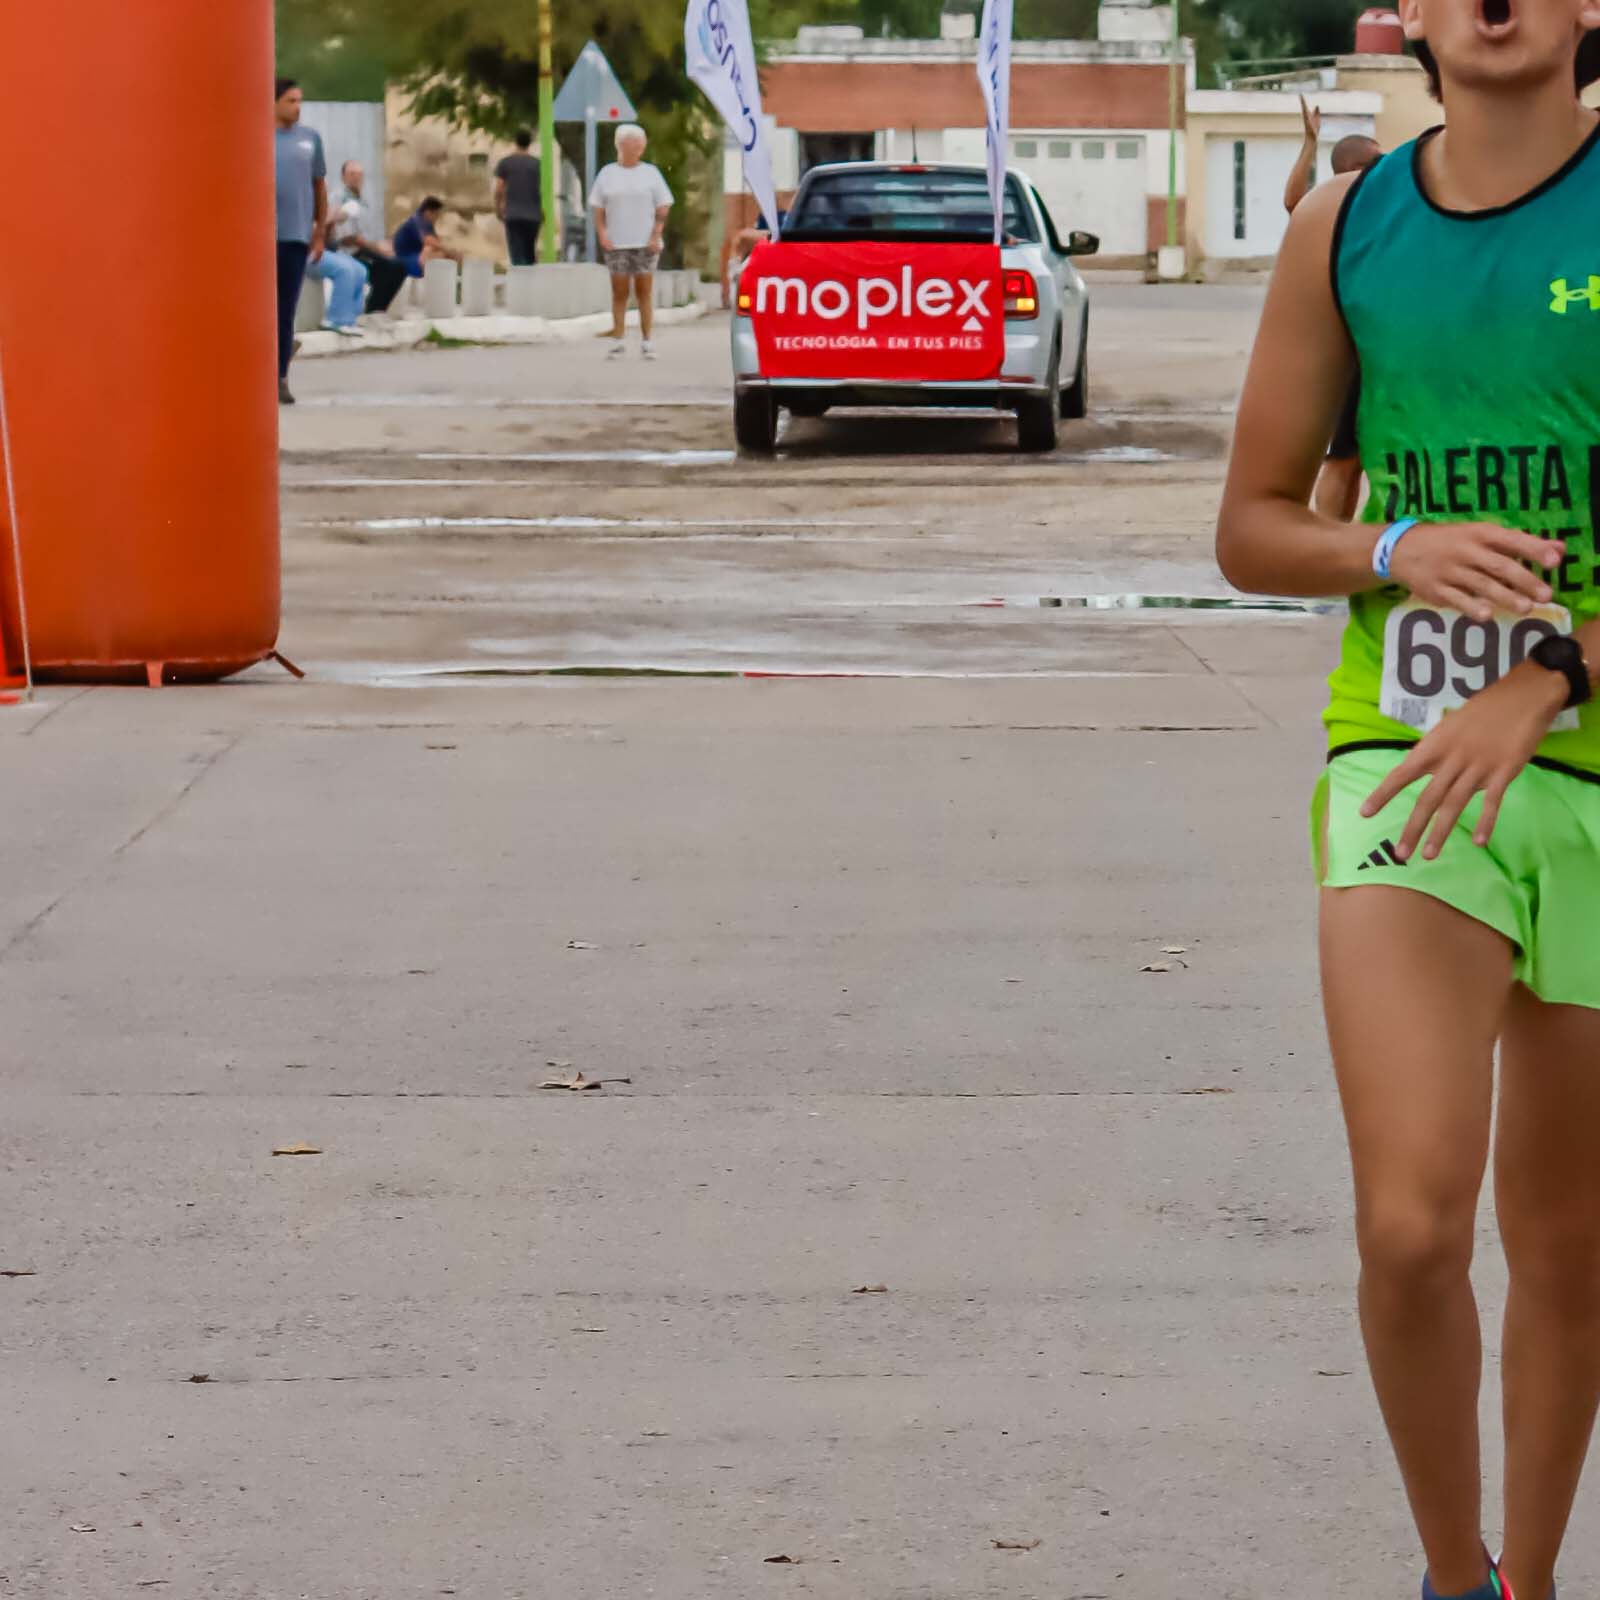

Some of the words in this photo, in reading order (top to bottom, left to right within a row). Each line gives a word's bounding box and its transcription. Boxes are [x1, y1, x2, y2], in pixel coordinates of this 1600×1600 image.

[756, 264, 992, 331] moplex
[774, 336, 878, 350] TECNOLOGIA
[887, 337, 910, 350] EN
[914, 337, 944, 351] TUS
[949, 337, 984, 350] PIES
